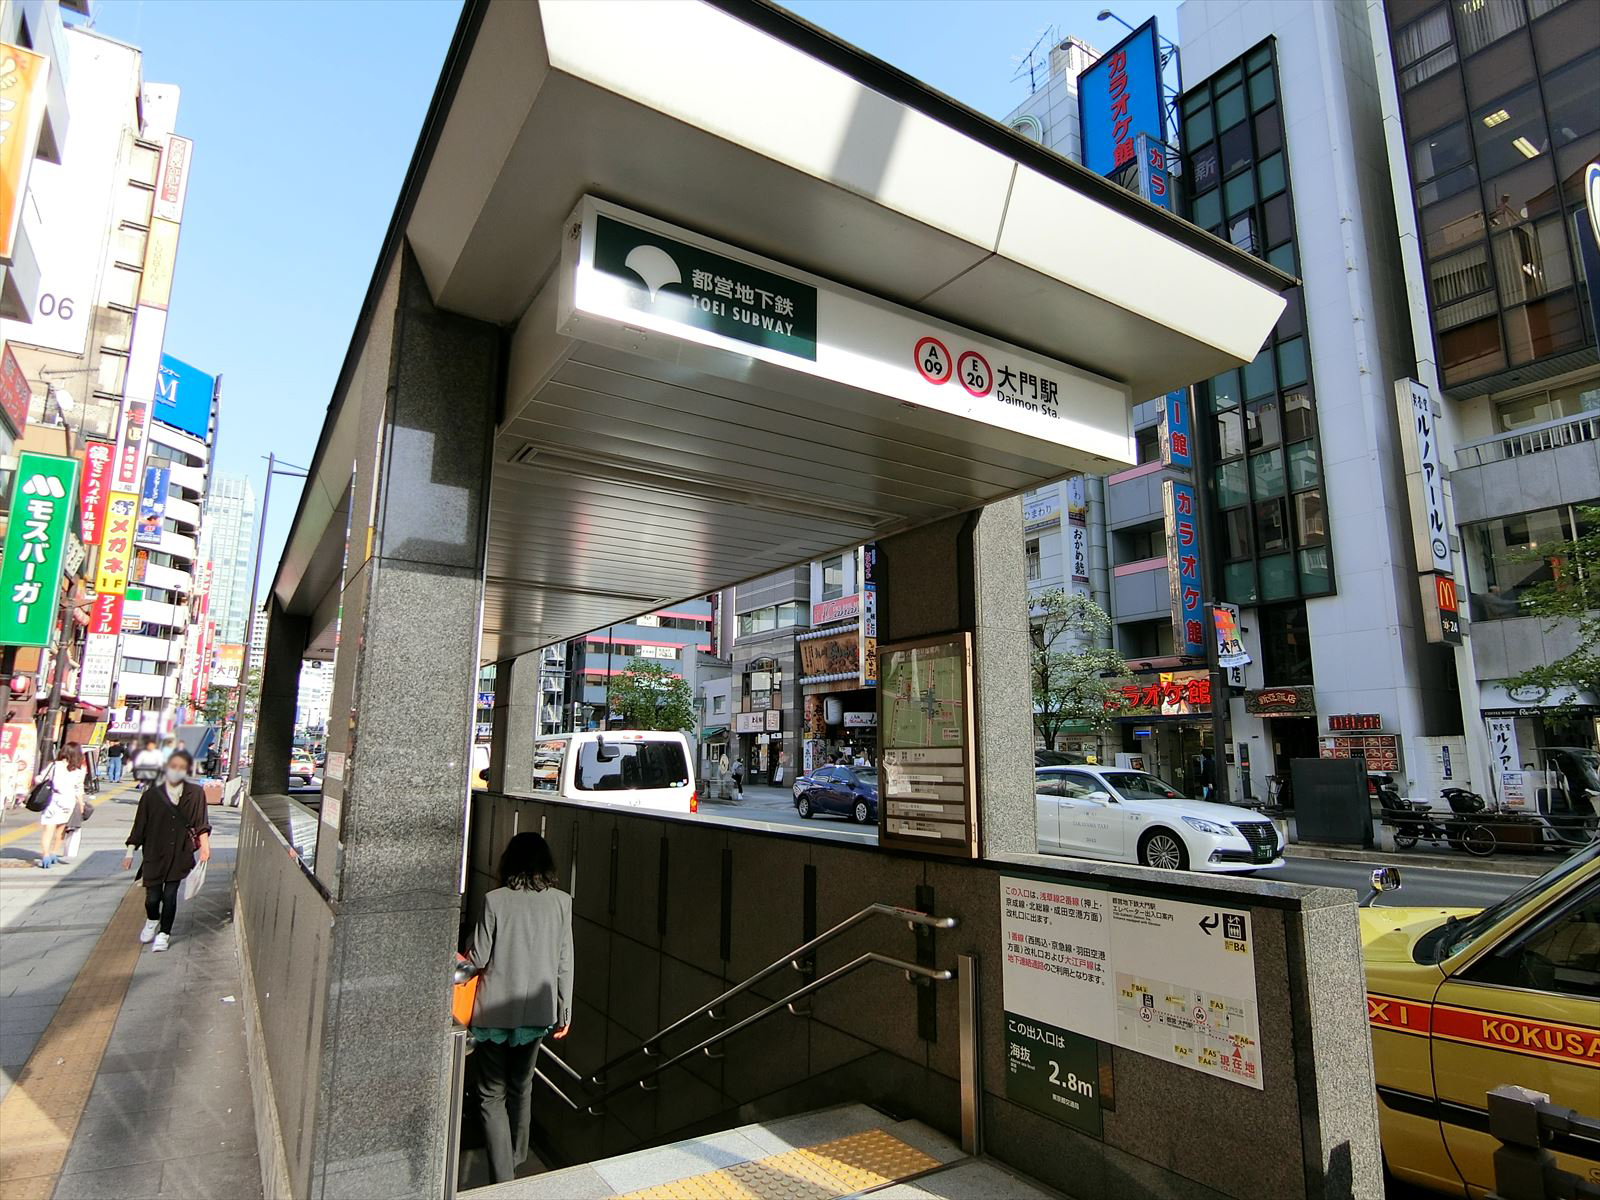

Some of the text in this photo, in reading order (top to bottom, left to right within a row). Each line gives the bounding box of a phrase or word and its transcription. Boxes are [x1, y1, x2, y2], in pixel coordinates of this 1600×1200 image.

[1107, 50, 1136, 169] カラオケ館
[1150, 148, 1167, 209] カラ
[39, 293, 75, 320] 06
[691, 268, 794, 318] 都営地下鉄
[691, 294, 794, 337] TOEI SUBWAY
[924, 358, 943, 375] 09
[928, 346, 939, 360] A
[971, 359, 979, 372] E
[966, 372, 984, 389] 20
[997, 365, 1059, 406] 大門駅
[996, 390, 1061, 420] Daimon Sta.
[1417, 414, 1444, 533] ルノアール
[1024, 505, 1052, 521] ひまわり
[12, 499, 54, 624] モスバーガー
[104, 519, 129, 573] メガネ
[1177, 492, 1204, 645] カラオケ館
[98, 595, 116, 633] アイフル
[216, 664, 239, 679] 大門
[1103, 679, 1212, 711] ラオケ館
[1496, 732, 1512, 770] ルノア
[1112, 905, 1174, 921] エレベーター出入口案内
[1233, 942, 1246, 953] B4
[1008, 1019, 1066, 1049] この出入口は
[1010, 1042, 1031, 1063] 海抜
[1220, 1054, 1255, 1074] 現在地
[1048, 1059, 1093, 1098] 2.8m
